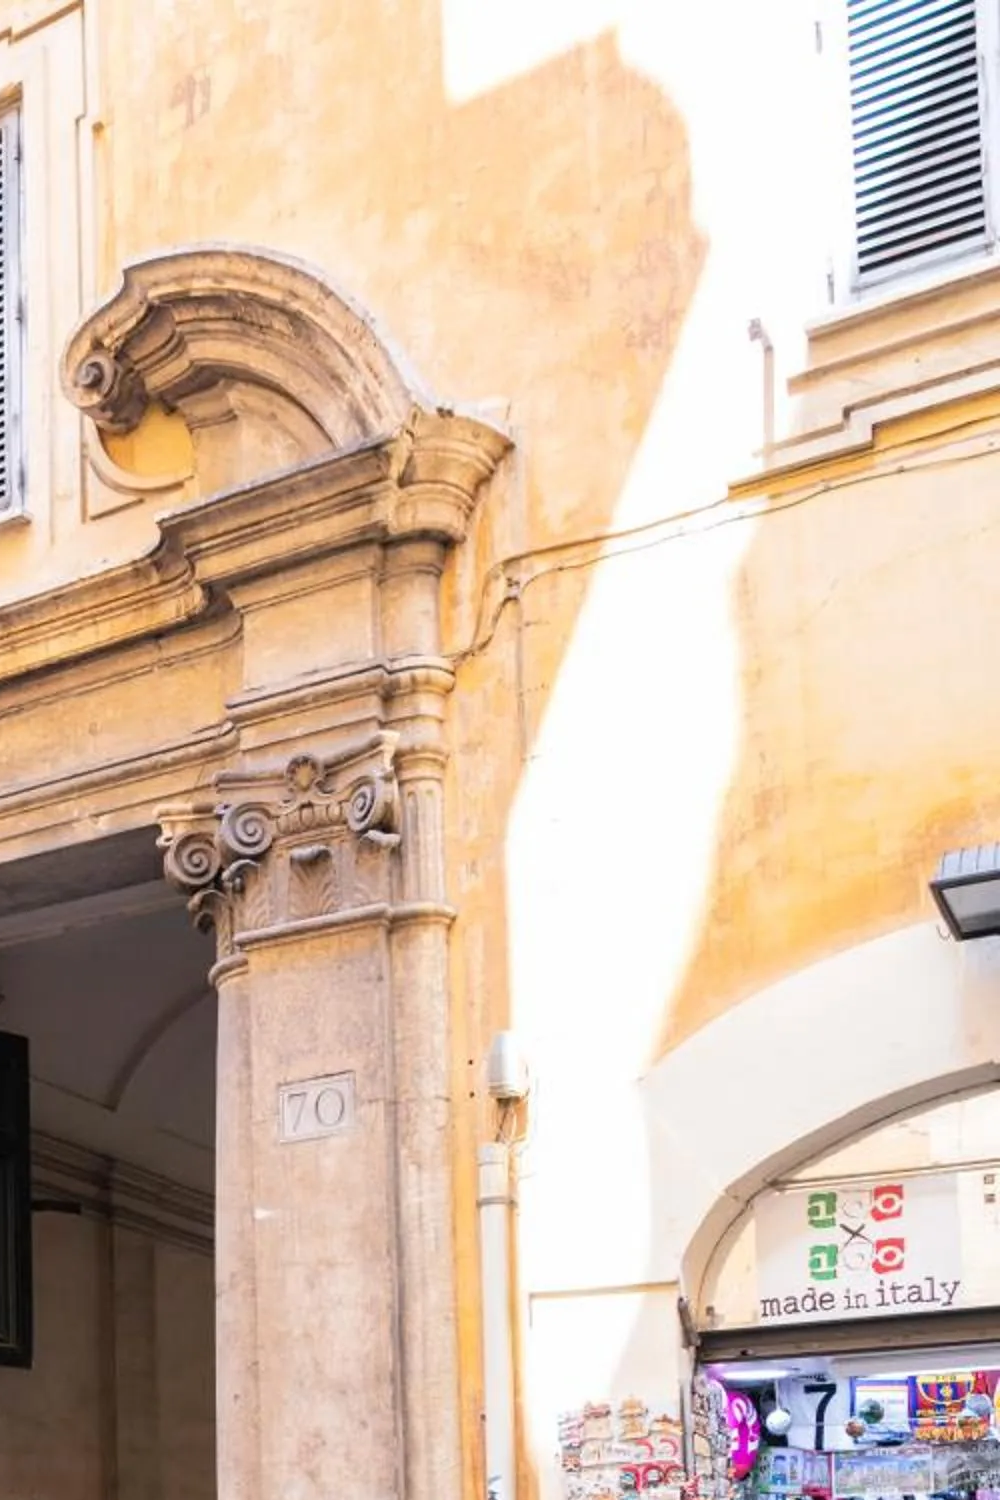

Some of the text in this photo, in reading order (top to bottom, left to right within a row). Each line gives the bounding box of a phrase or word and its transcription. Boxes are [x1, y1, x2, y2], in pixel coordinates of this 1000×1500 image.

[287, 1086, 345, 1133] 70
[761, 1276, 961, 1318] made in italy
[803, 1383, 837, 1450] 7
